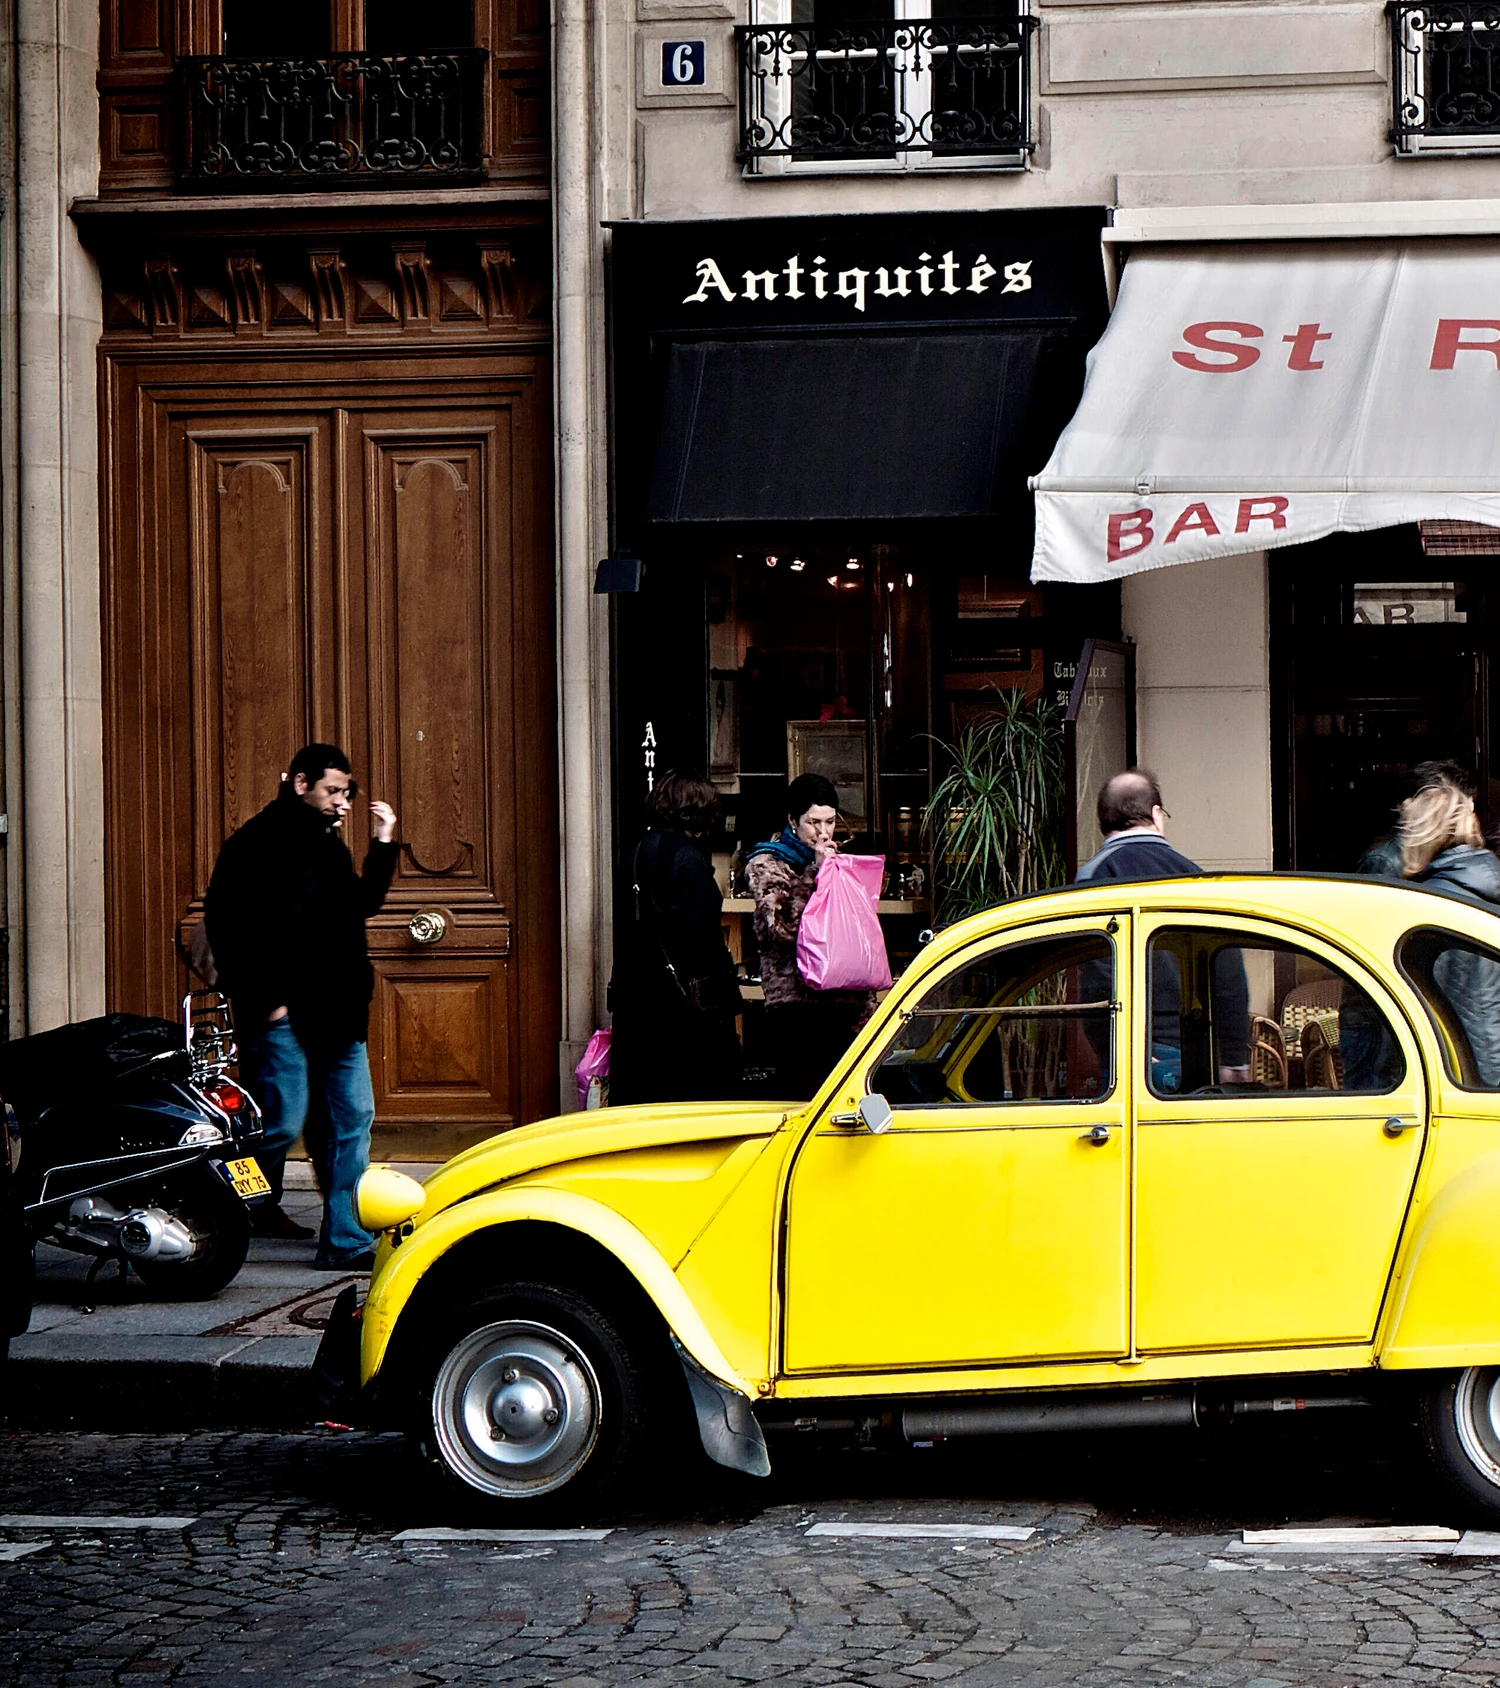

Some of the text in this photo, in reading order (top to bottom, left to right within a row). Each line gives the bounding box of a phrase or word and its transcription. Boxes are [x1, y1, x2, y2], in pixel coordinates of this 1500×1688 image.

[671, 44, 695, 82] 6
[682, 250, 1033, 313] Antiquités
[1172, 321, 1333, 375] St
[1107, 495, 1290, 563] BAR
[234, 1160, 251, 1176] 85
[252, 1175, 267, 1190] 75
